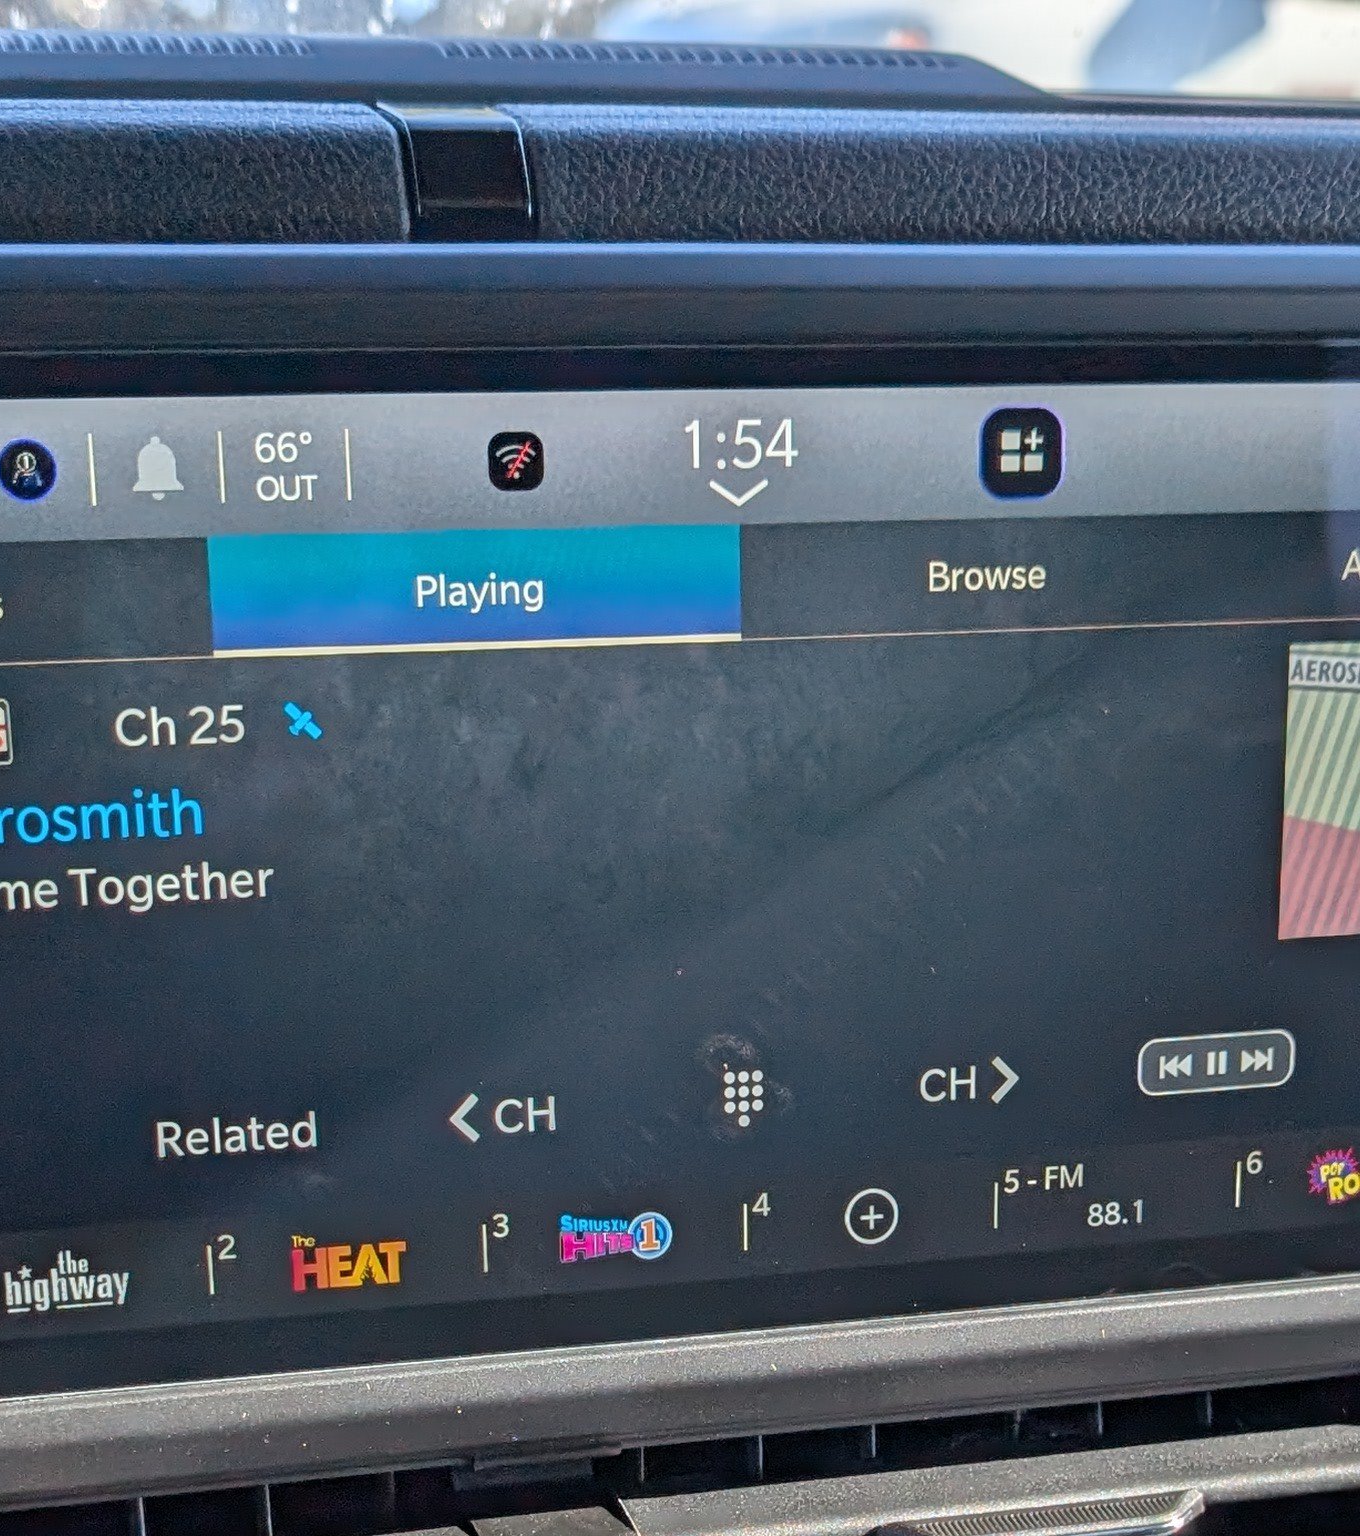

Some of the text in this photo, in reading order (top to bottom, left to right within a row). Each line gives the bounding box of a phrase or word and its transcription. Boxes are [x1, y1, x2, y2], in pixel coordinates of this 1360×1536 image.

[254, 430, 314, 465] 66°
[683, 418, 799, 470] 1:54
[255, 474, 317, 502] OUT
[415, 573, 544, 614] Playing
[927, 560, 1047, 593] Browse
[114, 705, 245, 748] Ch 25
[68, 862, 274, 913] Together
[919, 1065, 978, 1103] CH
[494, 1095, 557, 1136] CH
[155, 1110, 319, 1160] Related
[1044, 1163, 1084, 1191] FM
[1246, 1150, 1264, 1175] 6
[752, 1192, 771, 1217] 4
[1087, 1198, 1144, 1227] 88.1
[291, 1235, 316, 1248] The
[492, 1213, 510, 1238] 3
[560, 1218, 661, 1263] HITS 1
[57, 1250, 89, 1275] the
[217, 1234, 237, 1260] 2
[291, 1241, 407, 1292] HEAT
[3, 1266, 130, 1312] highway
